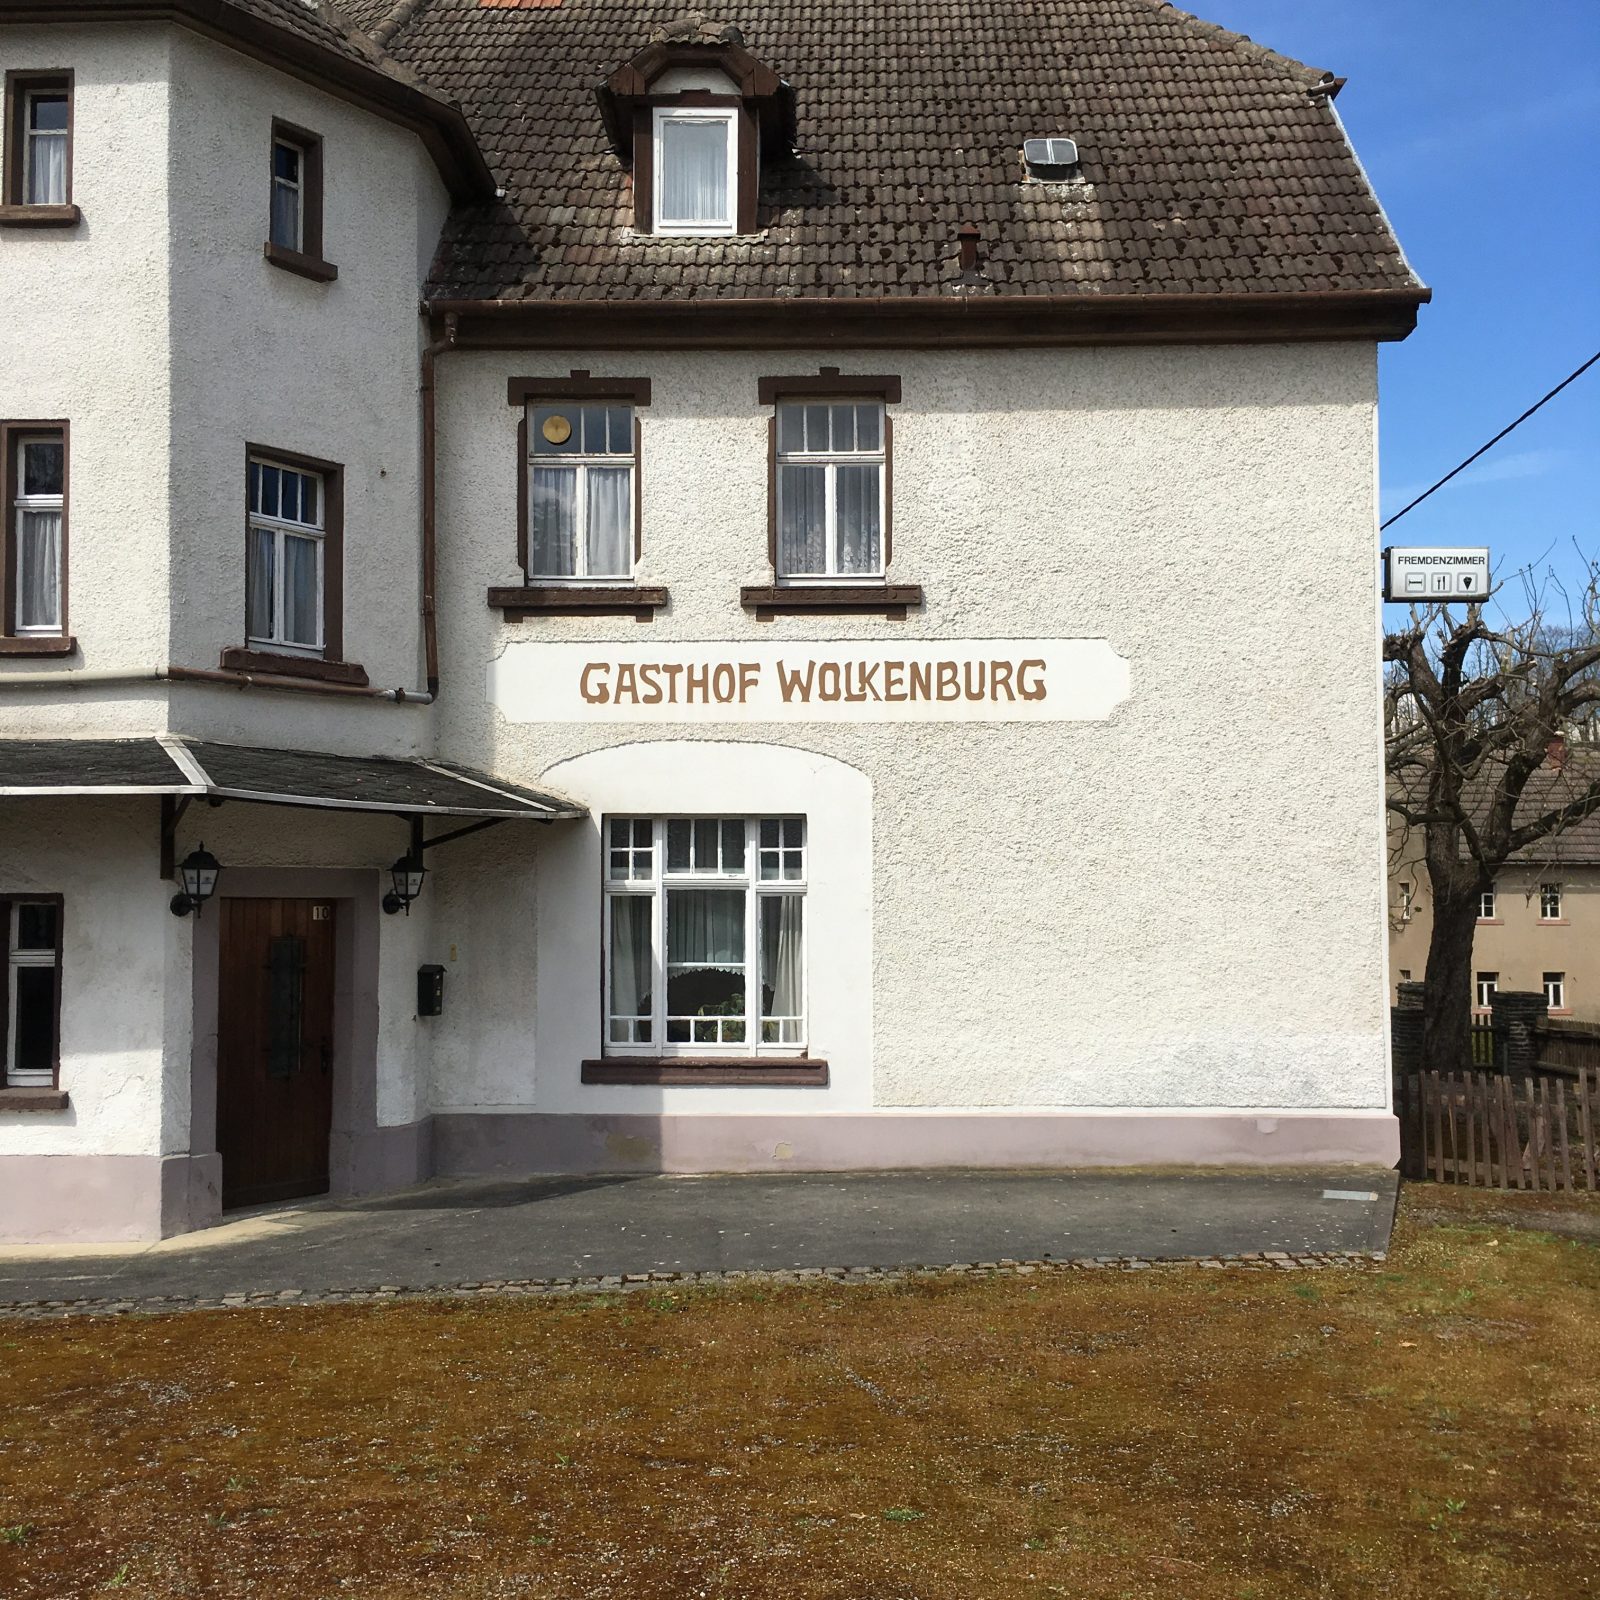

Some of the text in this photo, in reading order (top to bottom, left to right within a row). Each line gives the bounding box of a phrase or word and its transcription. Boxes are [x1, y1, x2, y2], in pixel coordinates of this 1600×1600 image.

[1398, 556, 1485, 565] FREMDENZIMMER
[579, 659, 1047, 704] GASTHOF WOLKENBURG
[315, 906, 329, 919] 10
